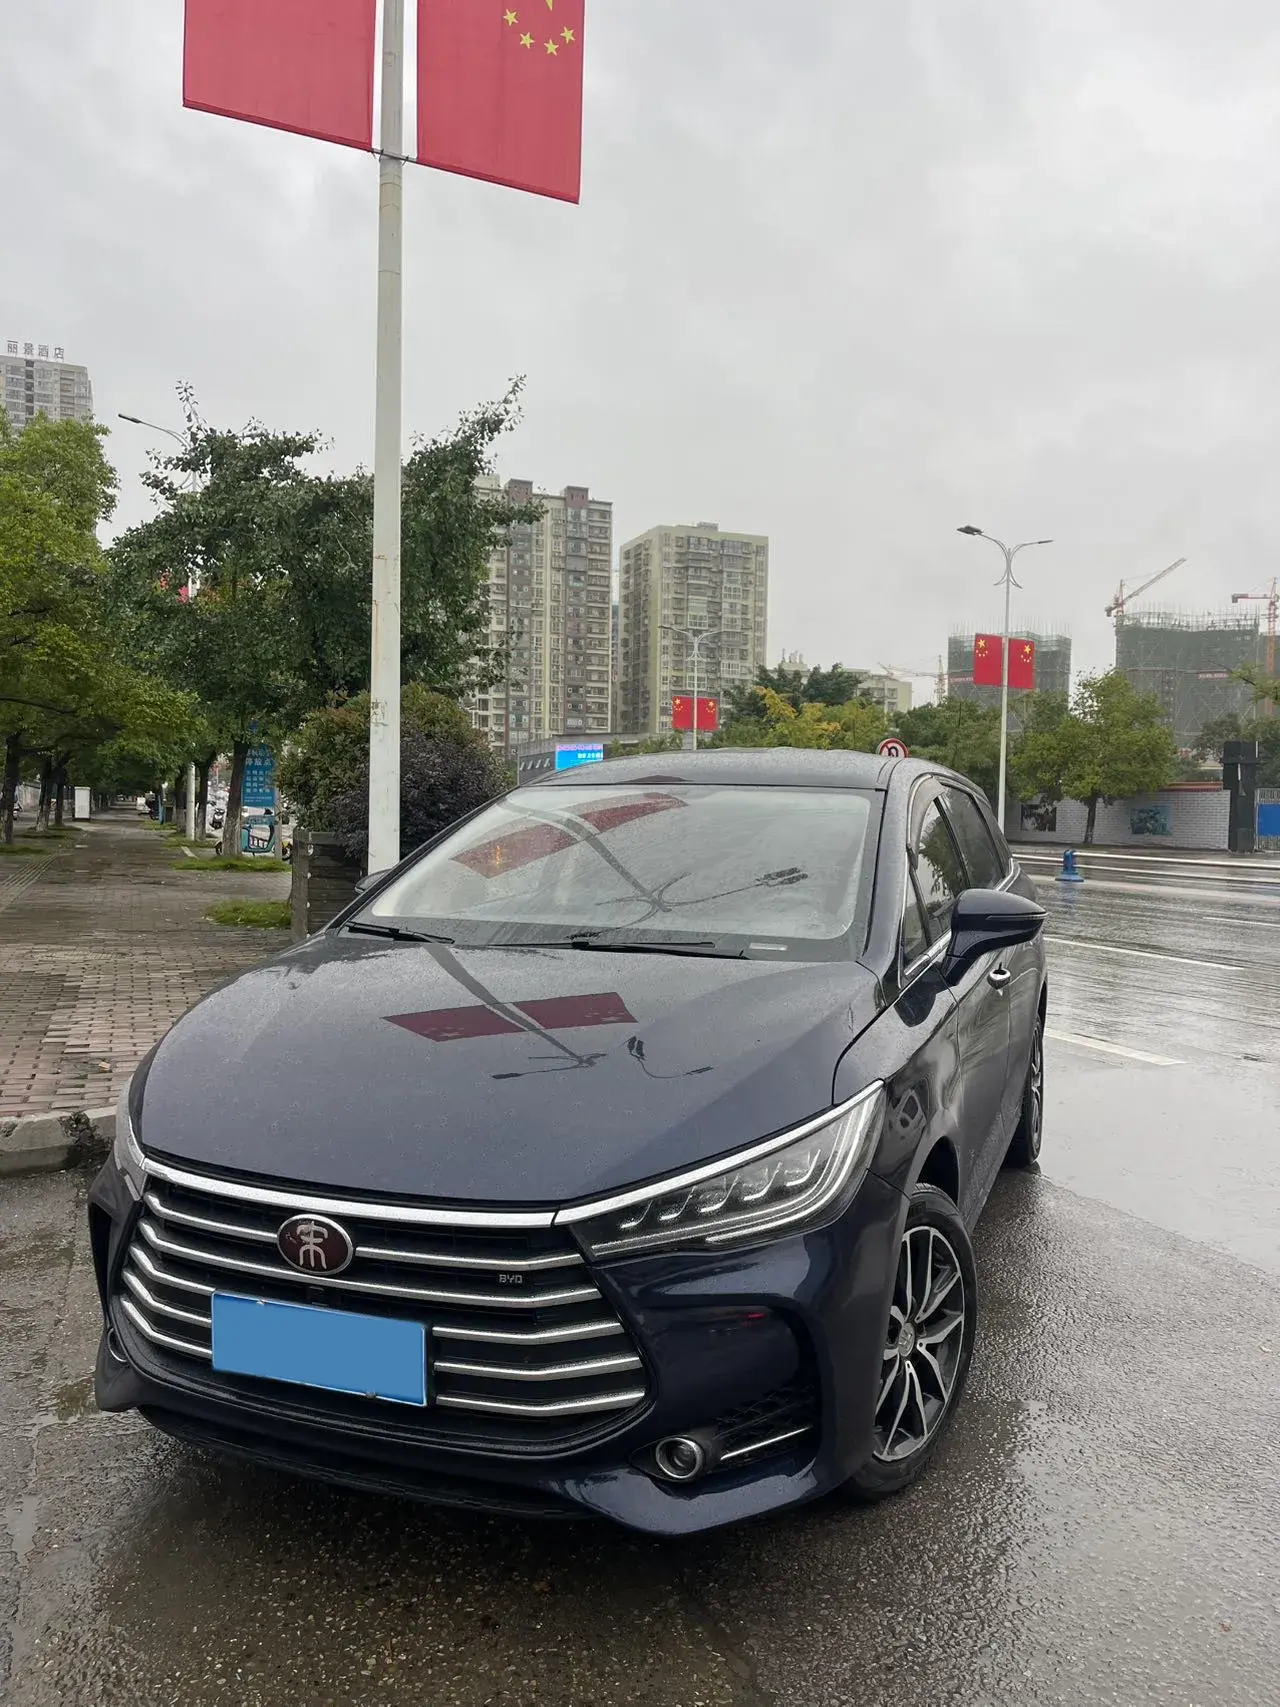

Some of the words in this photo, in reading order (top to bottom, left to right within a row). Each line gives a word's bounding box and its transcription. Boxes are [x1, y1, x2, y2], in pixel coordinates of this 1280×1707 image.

[7, 340, 65, 359] 丽景酒店
[499, 1274, 523, 1284] BYD
